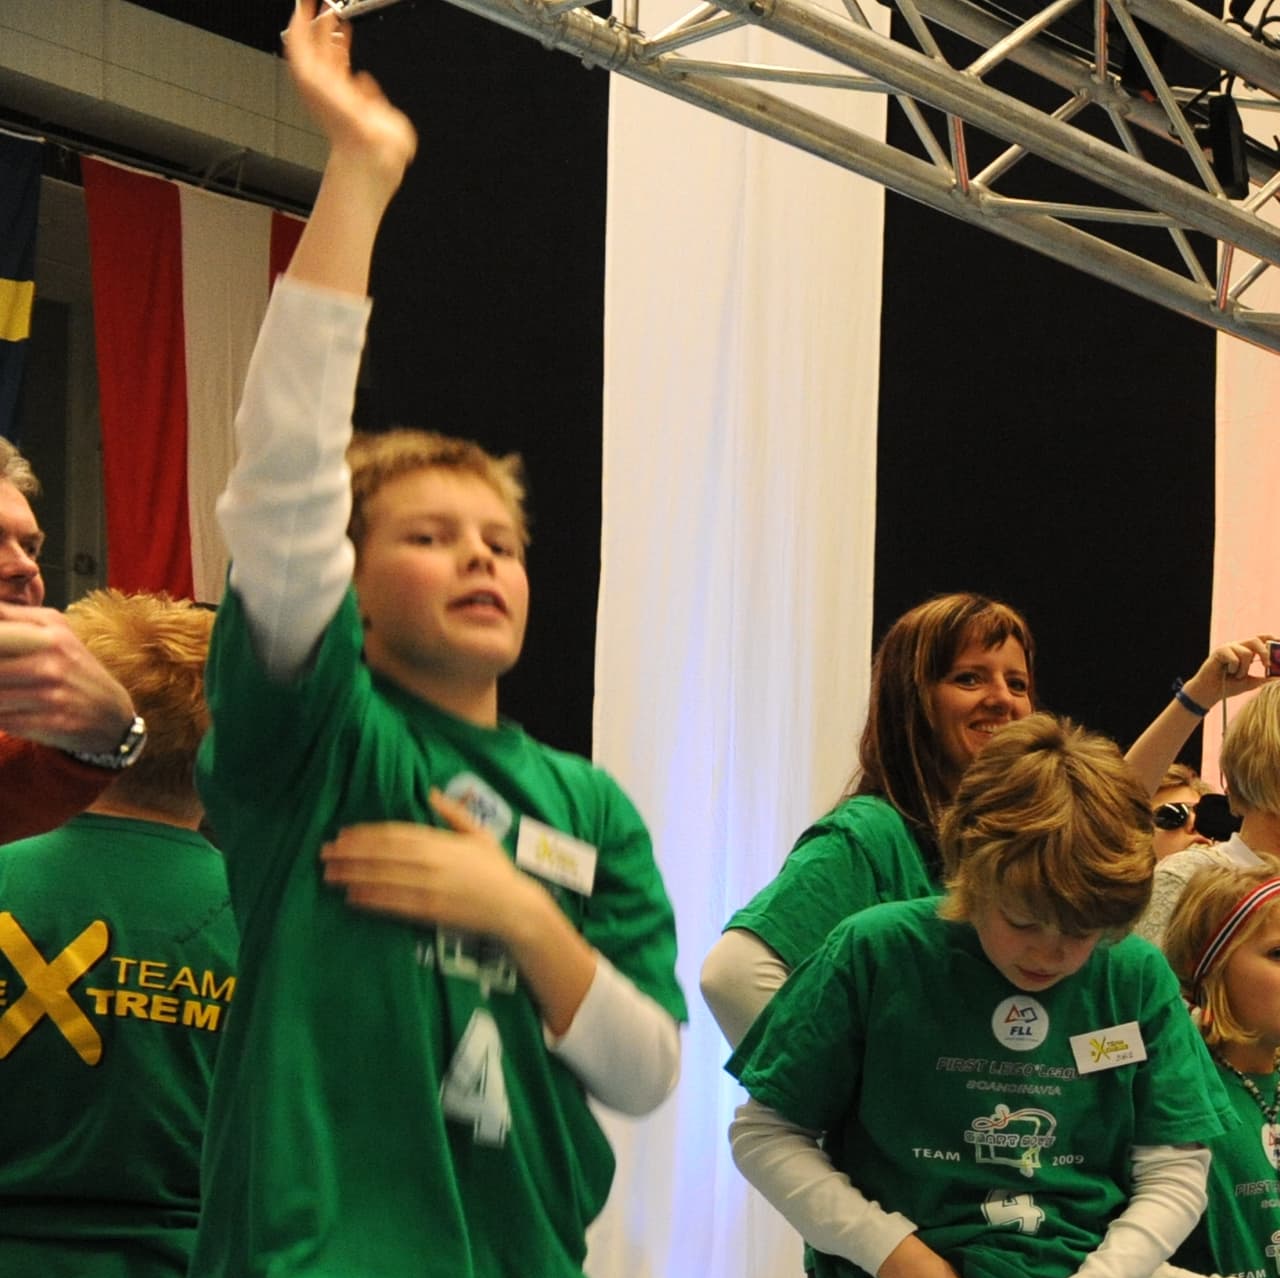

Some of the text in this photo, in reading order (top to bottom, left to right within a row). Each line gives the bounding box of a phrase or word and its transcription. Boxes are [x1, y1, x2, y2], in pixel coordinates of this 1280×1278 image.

[111, 957, 237, 1001] TEAM
[1010, 1026, 1033, 1036] FLL
[439, 1007, 512, 1149] 4
[912, 1148, 1084, 1166] TEAM 2009
